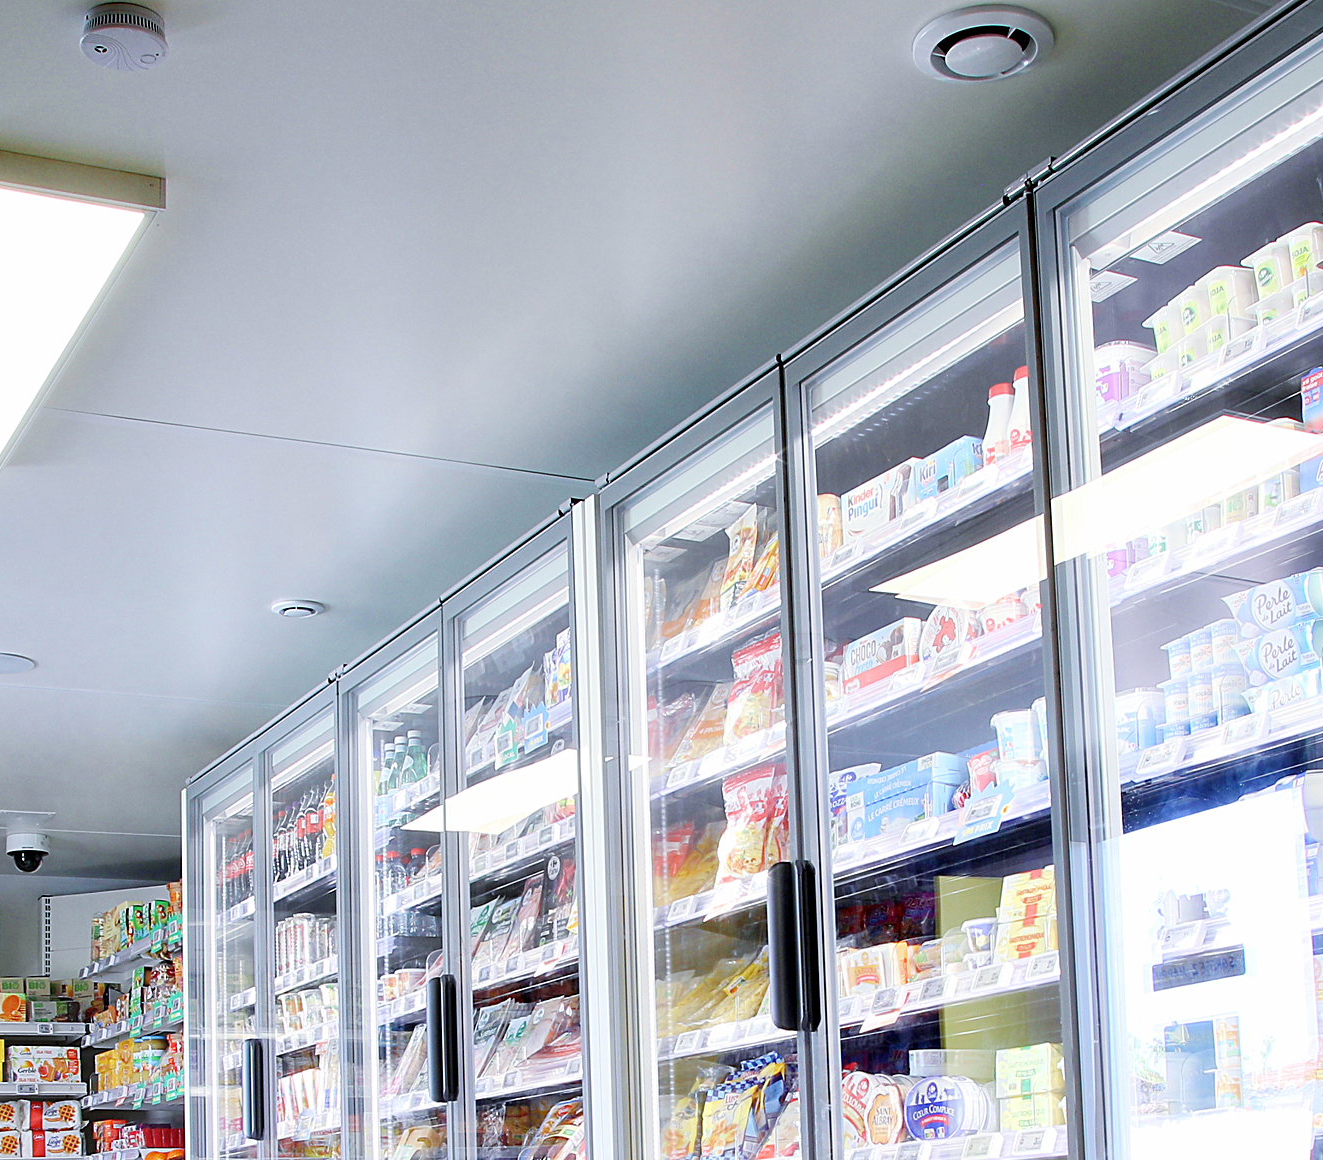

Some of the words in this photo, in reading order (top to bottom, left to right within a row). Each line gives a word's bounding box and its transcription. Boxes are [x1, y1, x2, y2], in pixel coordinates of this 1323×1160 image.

[919, 463, 936, 482] Kiri
[847, 488, 874, 507] Kinder
[1256, 587, 1291, 611] Perle
[1270, 601, 1293, 625] Lait
[850, 639, 876, 667] CHOCO
[1262, 638, 1295, 661] Perle
[1276, 651, 1298, 673] Lait
[1270, 684, 1302, 706] Perle
[867, 811, 878, 822] LE
[878, 804, 893, 818] CARRÉ
[893, 798, 919, 812] CRÉMEUX
[2, 981, 19, 992] BIO
[28, 981, 45, 992] BIO
[913, 1109, 929, 1121] CŒUR
